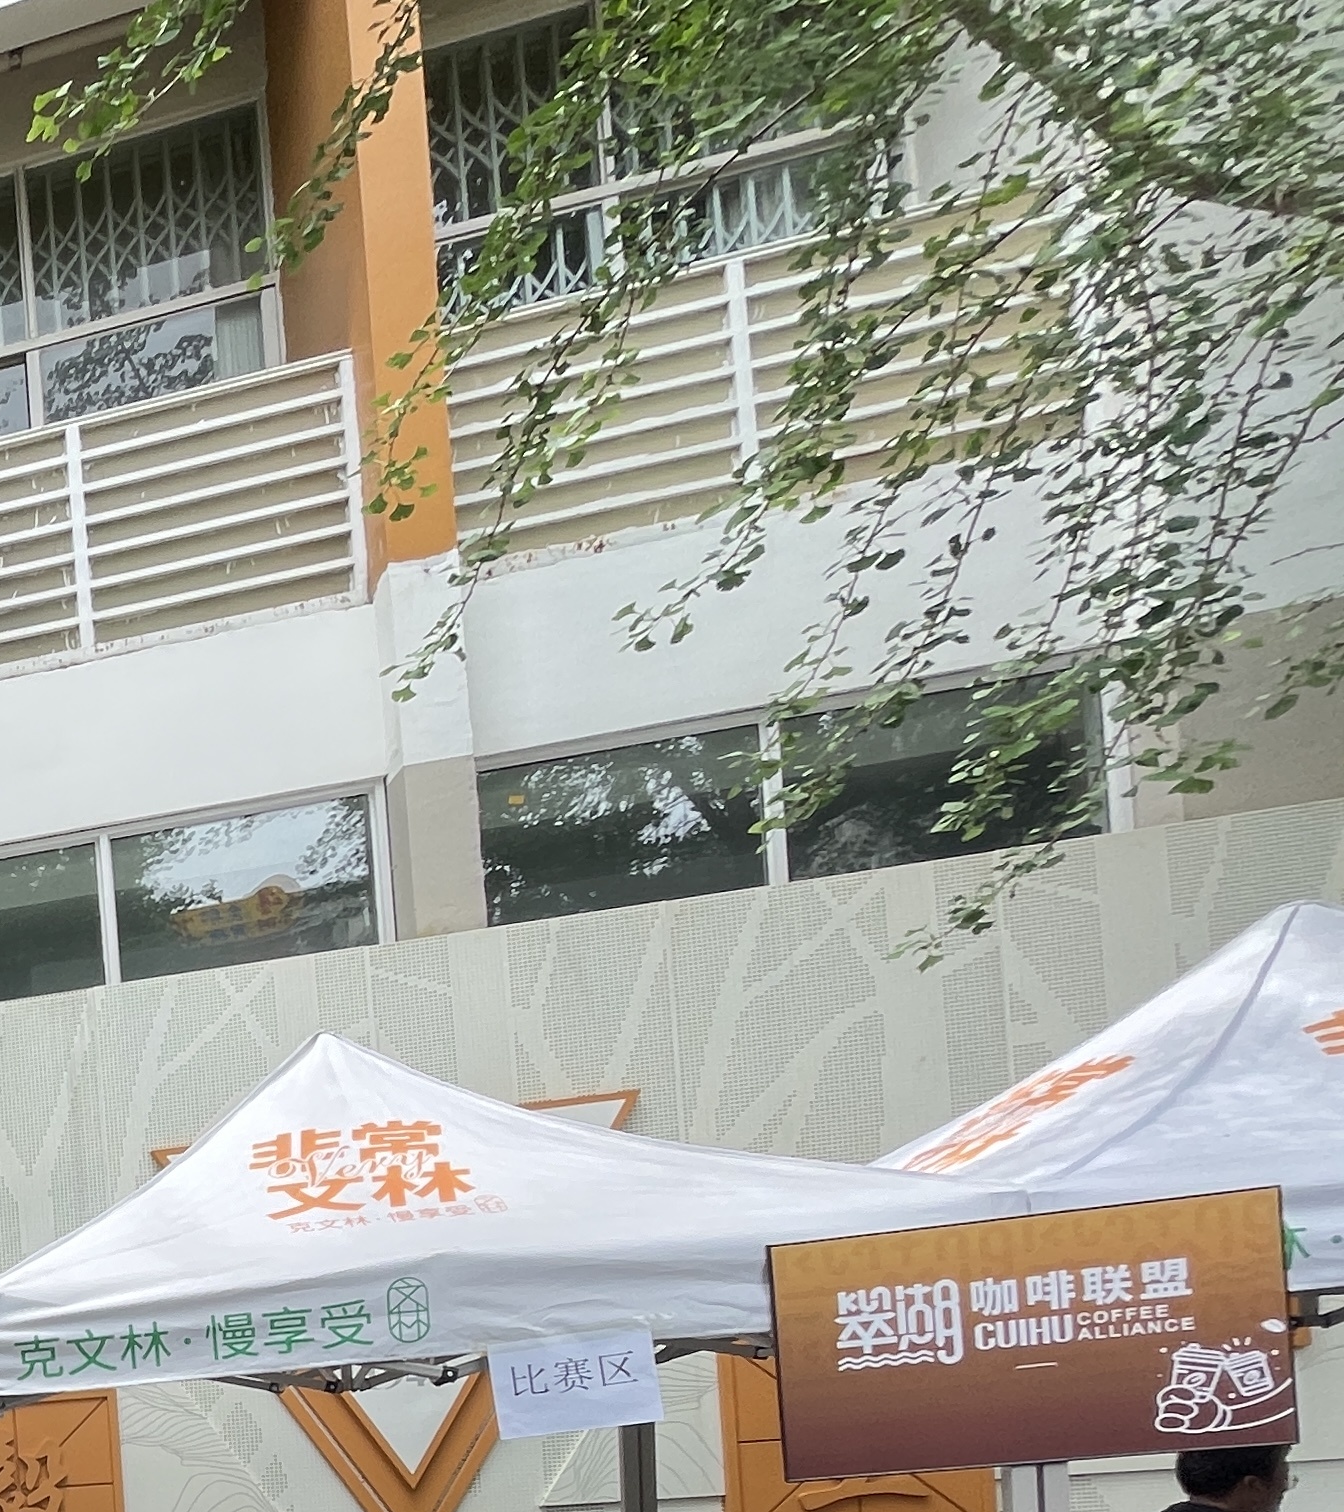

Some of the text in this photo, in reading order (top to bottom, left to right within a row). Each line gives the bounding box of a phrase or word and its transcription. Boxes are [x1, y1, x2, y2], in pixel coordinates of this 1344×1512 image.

[249, 1120, 443, 1171] 非常
[265, 1161, 476, 1221] 文林
[969, 1257, 1193, 1317] 咖啡联盟
[973, 1313, 1074, 1352] CUIHU
[1076, 1303, 1170, 1327] COFFEE
[1076, 1316, 1197, 1342] ALLIANCE
[511, 1350, 639, 1396] 比赛区
